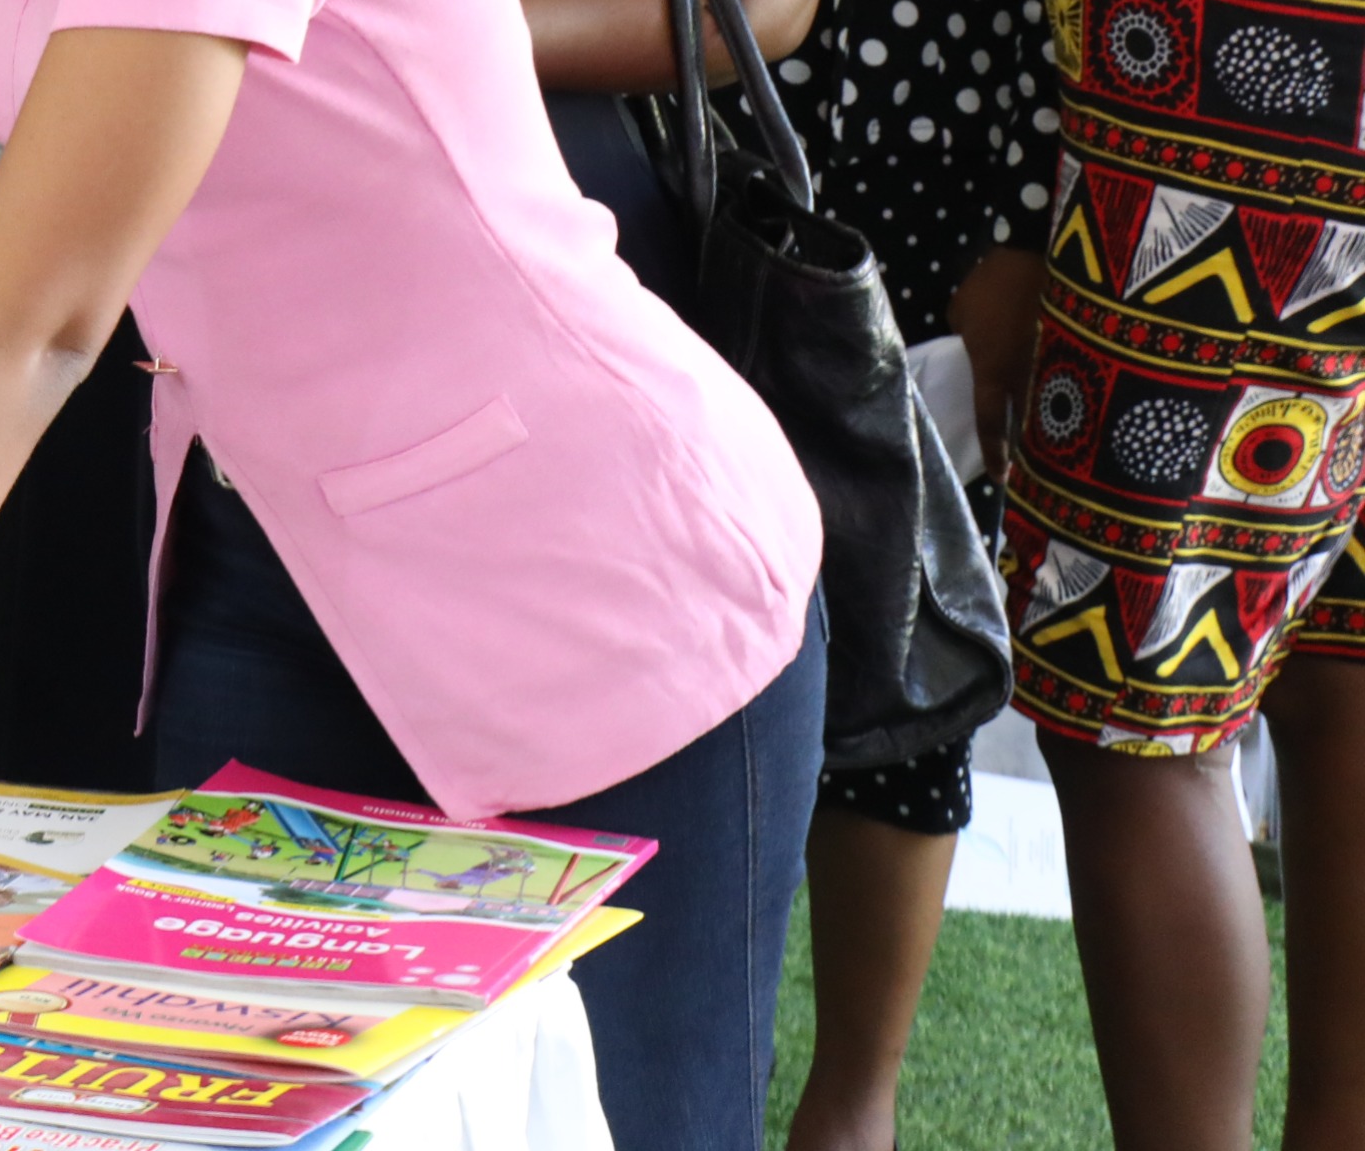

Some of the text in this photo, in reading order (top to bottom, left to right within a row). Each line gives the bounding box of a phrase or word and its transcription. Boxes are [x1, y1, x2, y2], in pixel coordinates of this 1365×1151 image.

[114, 884, 236, 913] Learner's Book
[153, 916, 426, 961] Language
[234, 909, 391, 939] Activities
[59, 978, 352, 1030] Kiswahili
[24, 1127, 159, 1151] Practice
